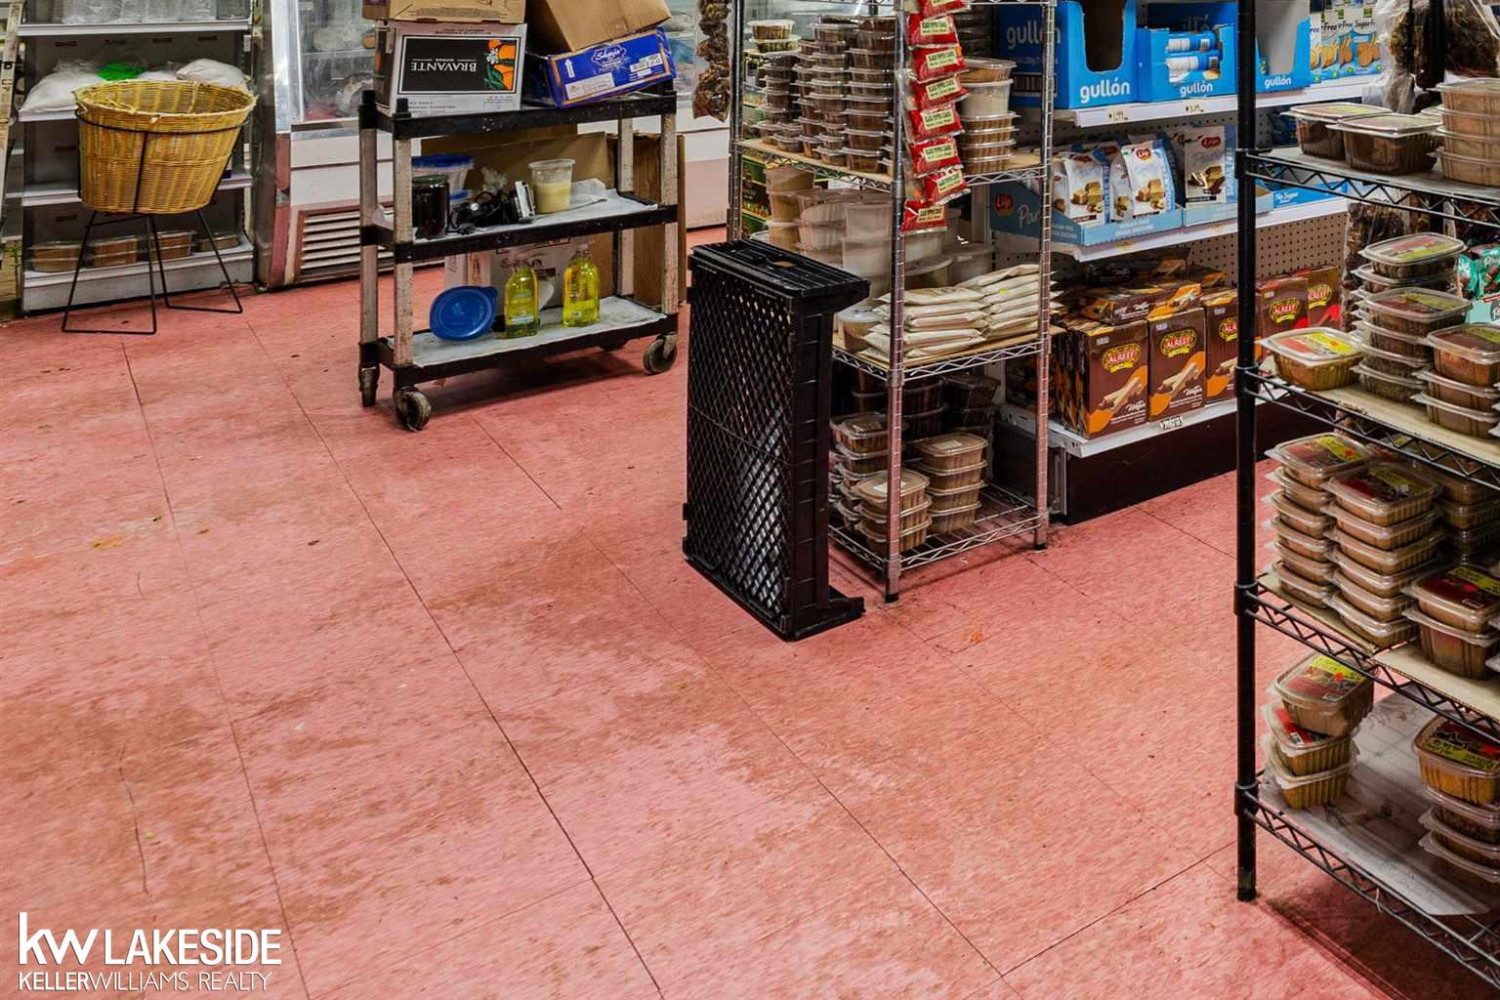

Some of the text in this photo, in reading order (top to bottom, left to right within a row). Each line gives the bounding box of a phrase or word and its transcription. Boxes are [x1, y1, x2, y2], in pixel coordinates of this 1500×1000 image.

[410, 61, 477, 72] BRAVANTE
[1180, 81, 1213, 97] gullón
[1264, 76, 1292, 89] gullón
[1080, 77, 1130, 103] gullón
